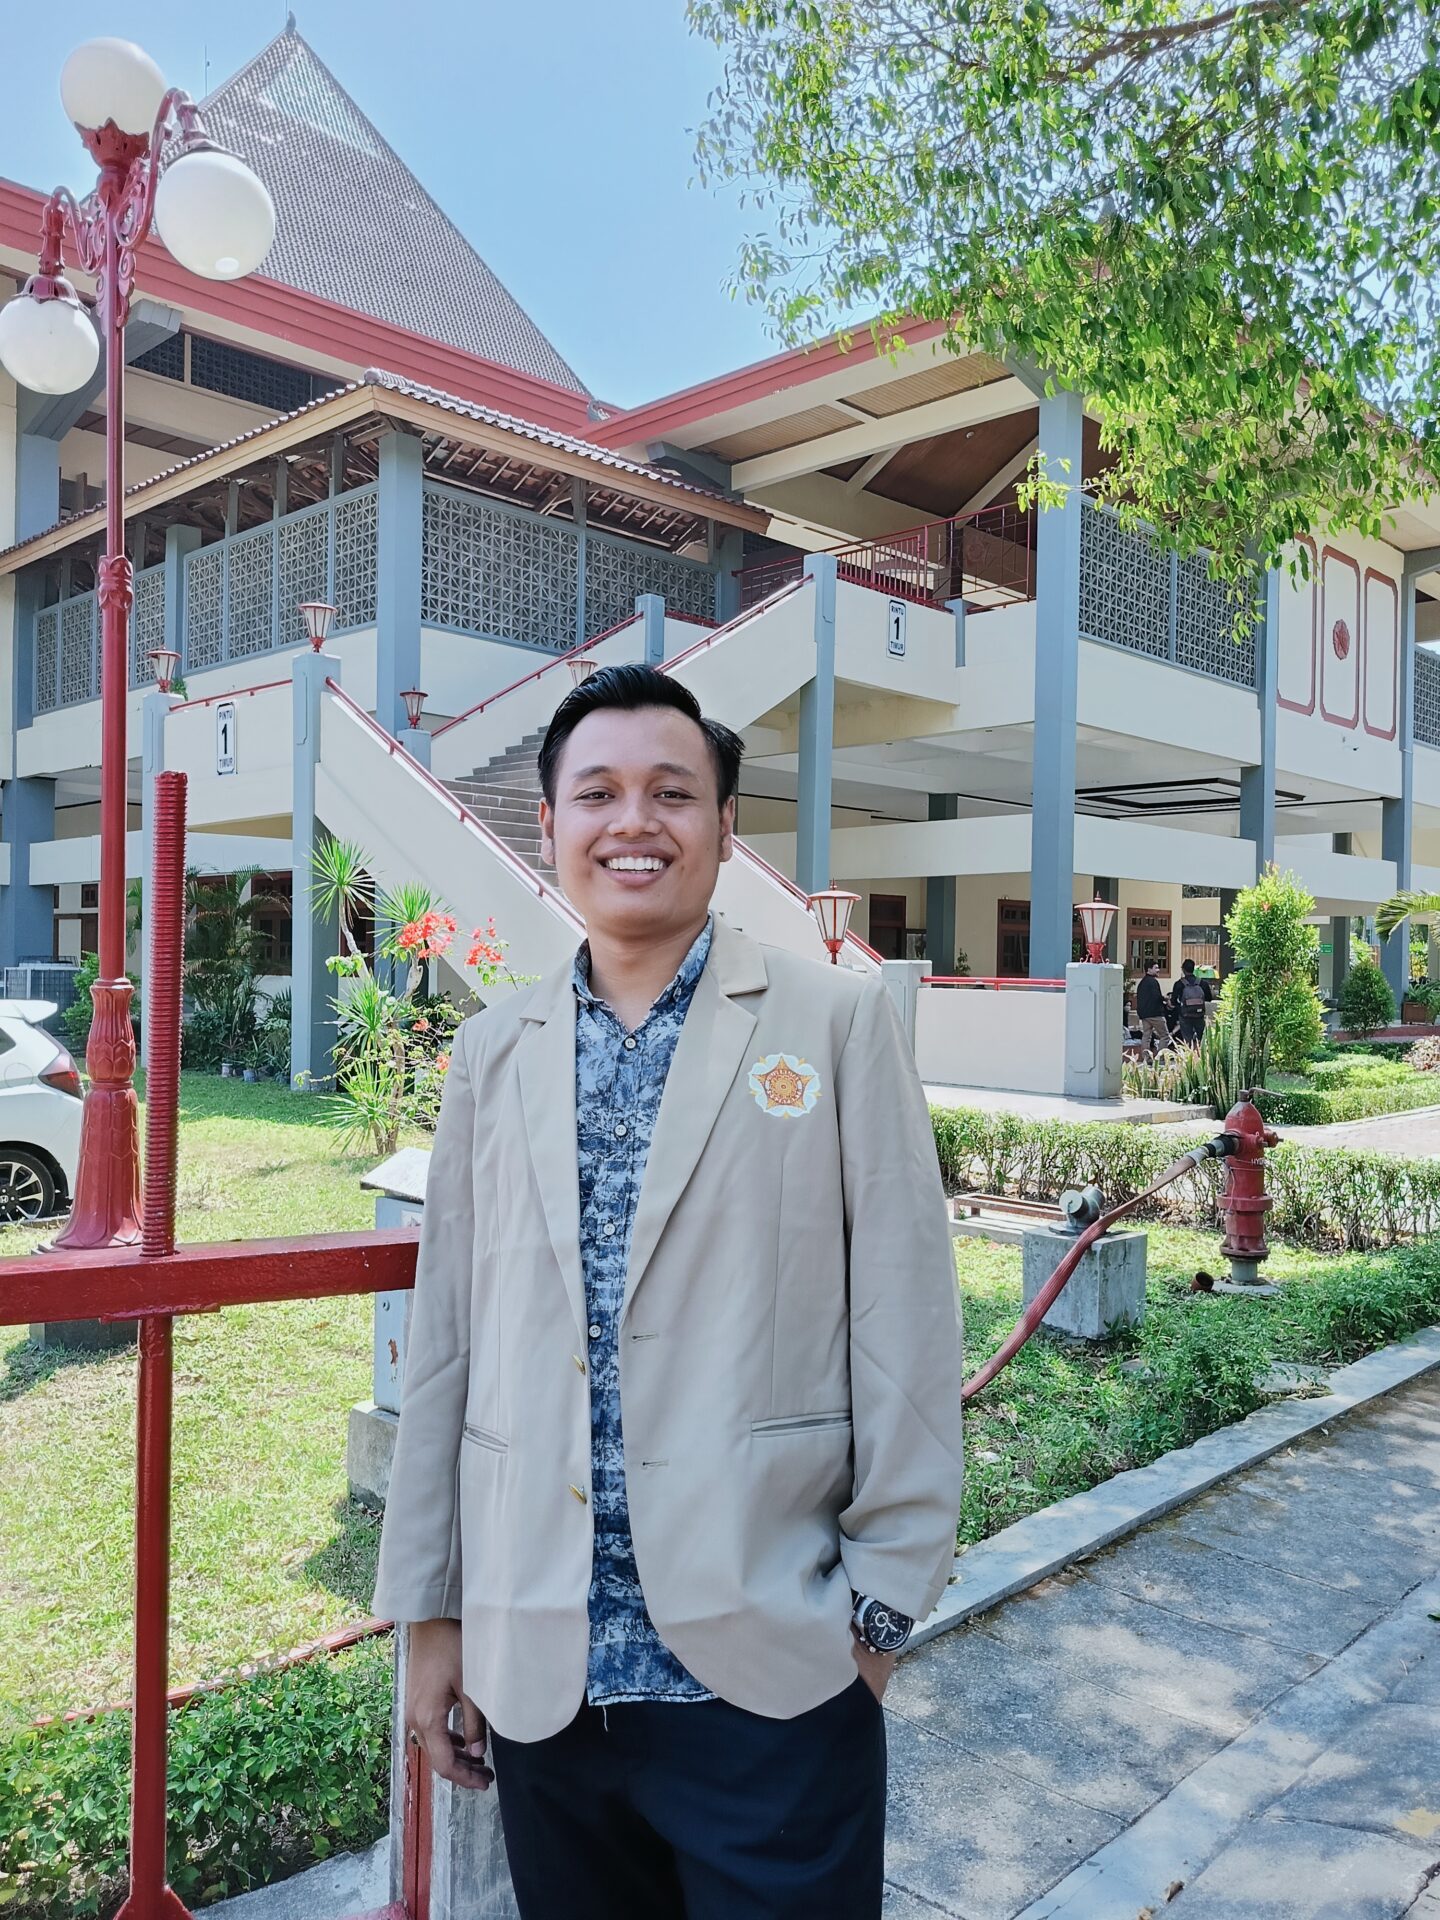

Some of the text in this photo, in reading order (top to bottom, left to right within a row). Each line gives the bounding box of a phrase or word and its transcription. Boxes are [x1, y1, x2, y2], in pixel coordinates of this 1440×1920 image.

[891, 605, 904, 616] PINTU
[893, 616, 900, 640] 1
[890, 640, 903, 651] TIMUR
[219, 709, 232, 720] PINTU
[221, 723, 227, 755] 1
[219, 757, 233, 769] TIMUR
